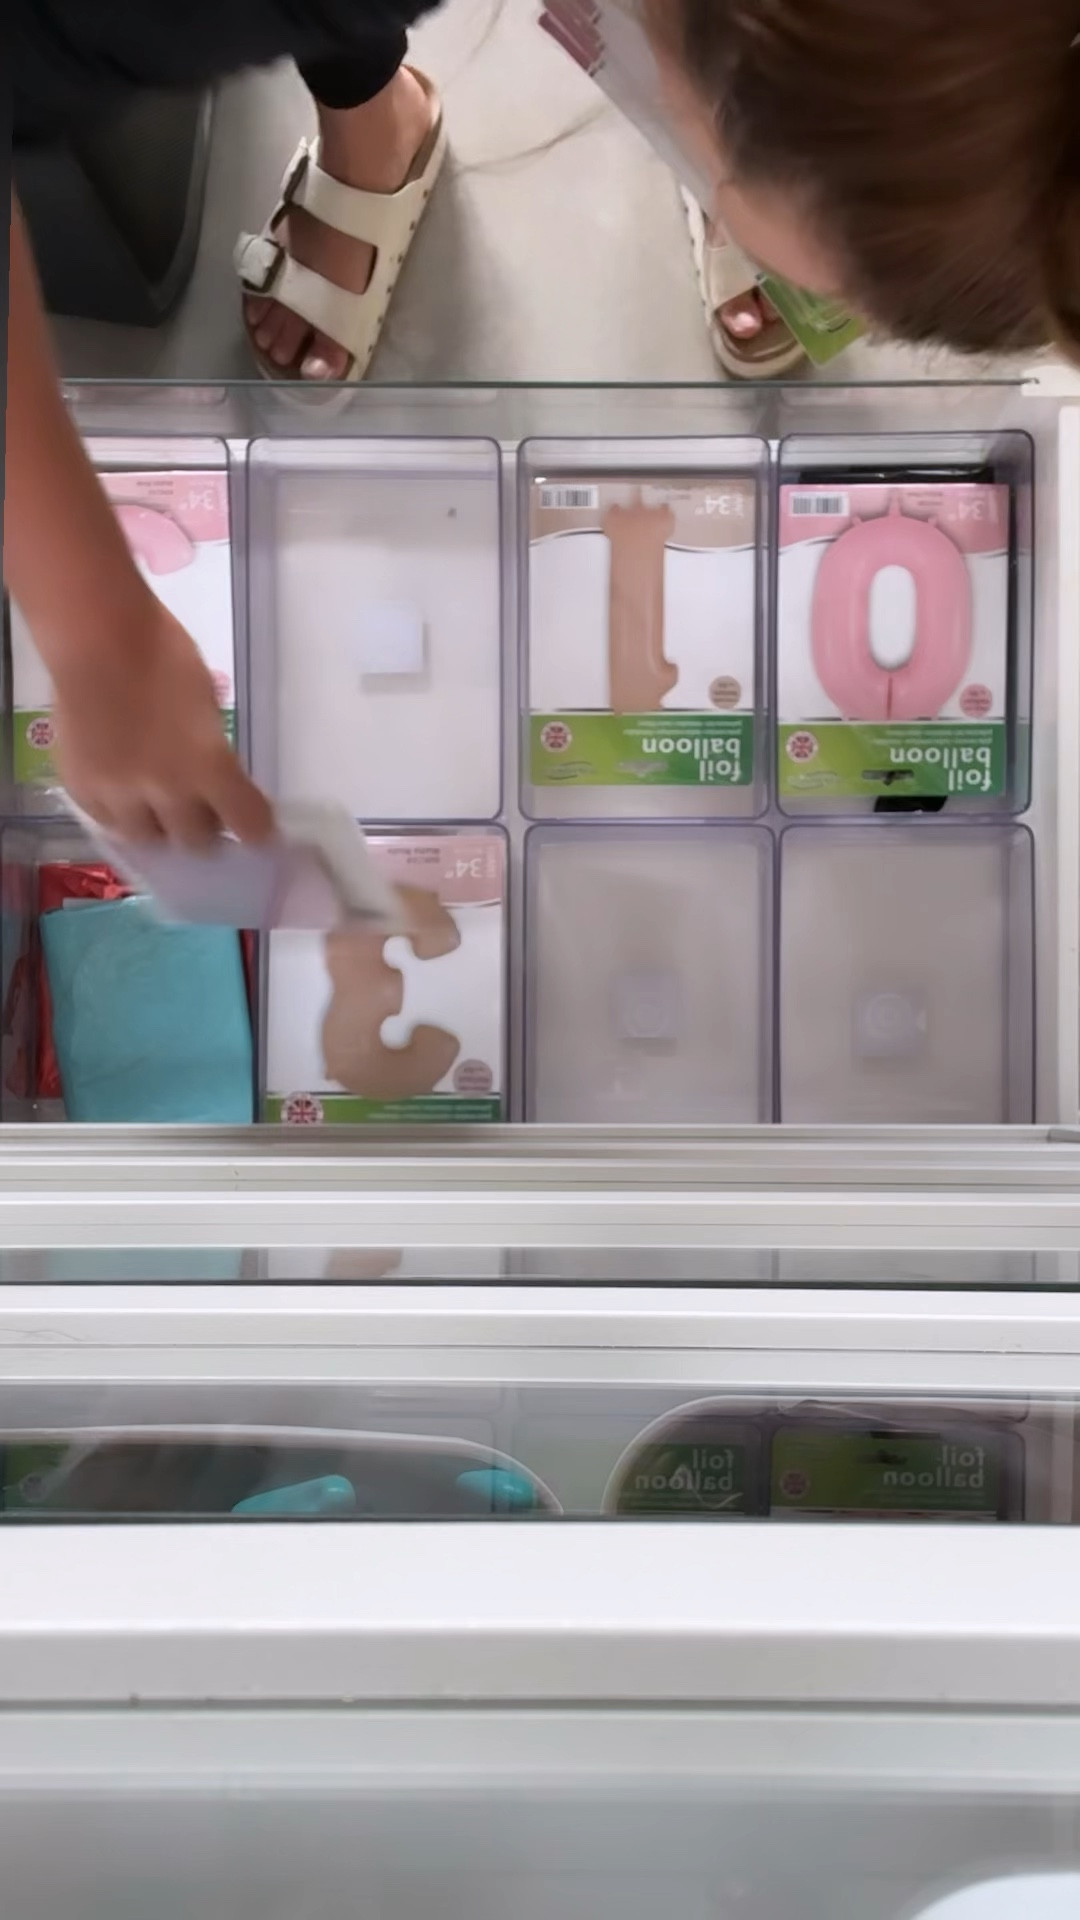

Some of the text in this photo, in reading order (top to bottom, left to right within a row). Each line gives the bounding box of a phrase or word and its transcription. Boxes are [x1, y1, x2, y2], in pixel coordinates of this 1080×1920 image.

[642, 738, 741, 759] balloon
[889, 747, 991, 769] balloon
[699, 759, 742, 782] foil
[948, 769, 992, 792] foil
